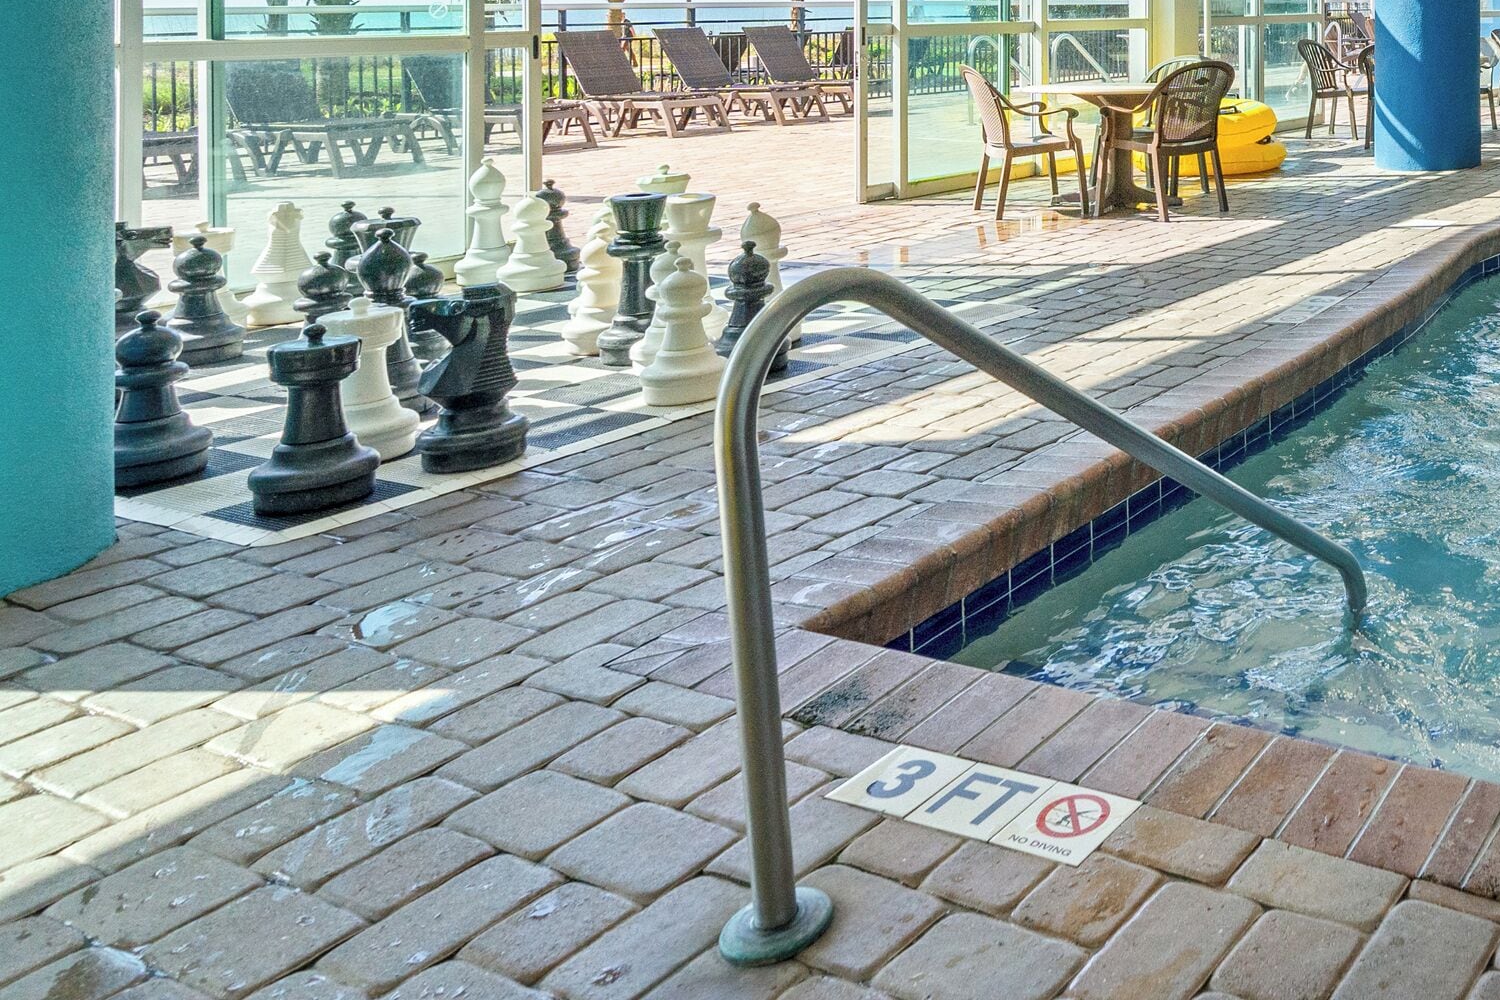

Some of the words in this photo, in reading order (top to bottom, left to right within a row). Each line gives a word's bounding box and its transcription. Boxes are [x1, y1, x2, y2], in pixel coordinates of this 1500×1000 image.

[865, 759, 937, 799] 3
[924, 771, 1040, 825] FT
[1008, 833, 1029, 844] NO
[1030, 840, 1072, 857] DIVING
